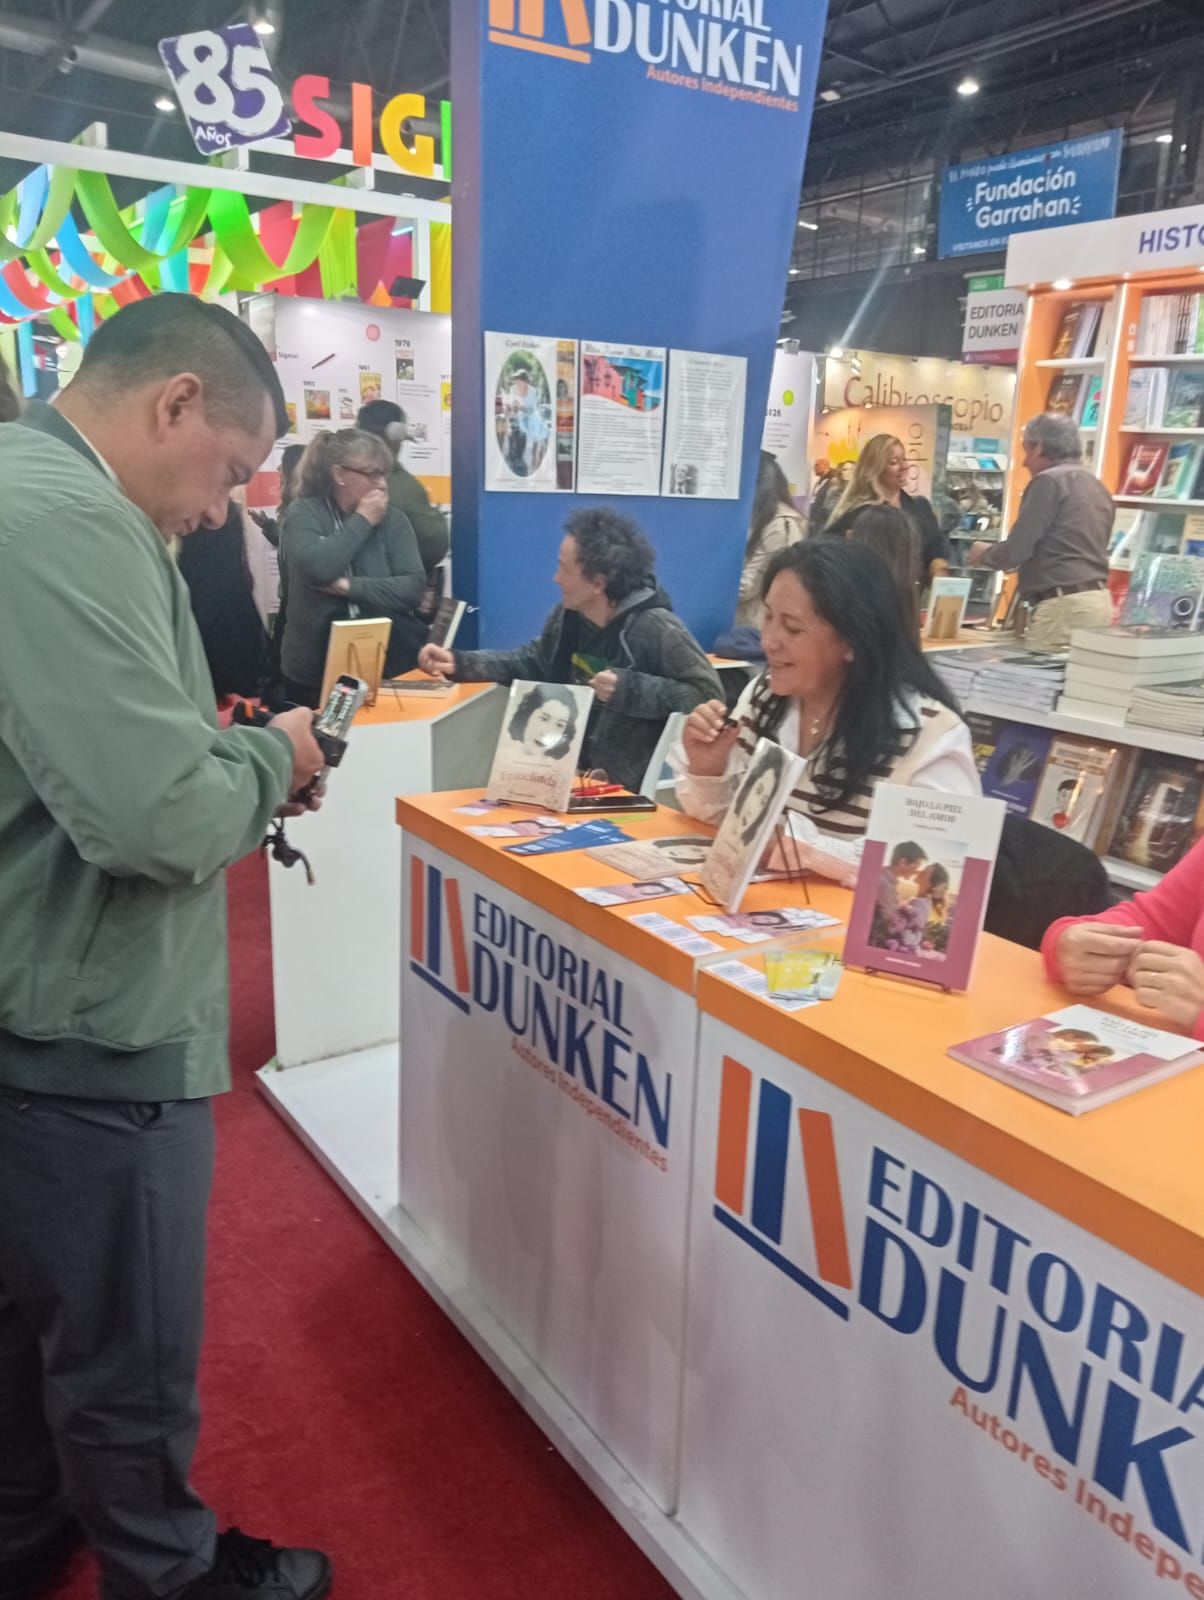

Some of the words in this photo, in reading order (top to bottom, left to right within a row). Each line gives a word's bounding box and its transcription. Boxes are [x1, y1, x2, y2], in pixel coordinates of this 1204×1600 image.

[594, 0, 802, 97] DUNKEN
[646, 64, 700, 90] Autores
[176, 29, 284, 136] 85
[194, 126, 232, 147] AÑOS
[291, 74, 452, 182] SIG
[975, 166, 1076, 204] Fundación
[975, 197, 1070, 229] Garrahan
[968, 322, 1018, 339] DUNKEN
[970, 303, 1024, 320] EDITORIA
[766, 408, 782, 418] 026
[473, 892, 633, 1037] EDITORIAL
[473, 940, 672, 1150] DUNKEN
[858, 1216, 1204, 1566] DUNK
[949, 1385, 1068, 1492] Autores
[1074, 1478, 1204, 1600] Indepe
